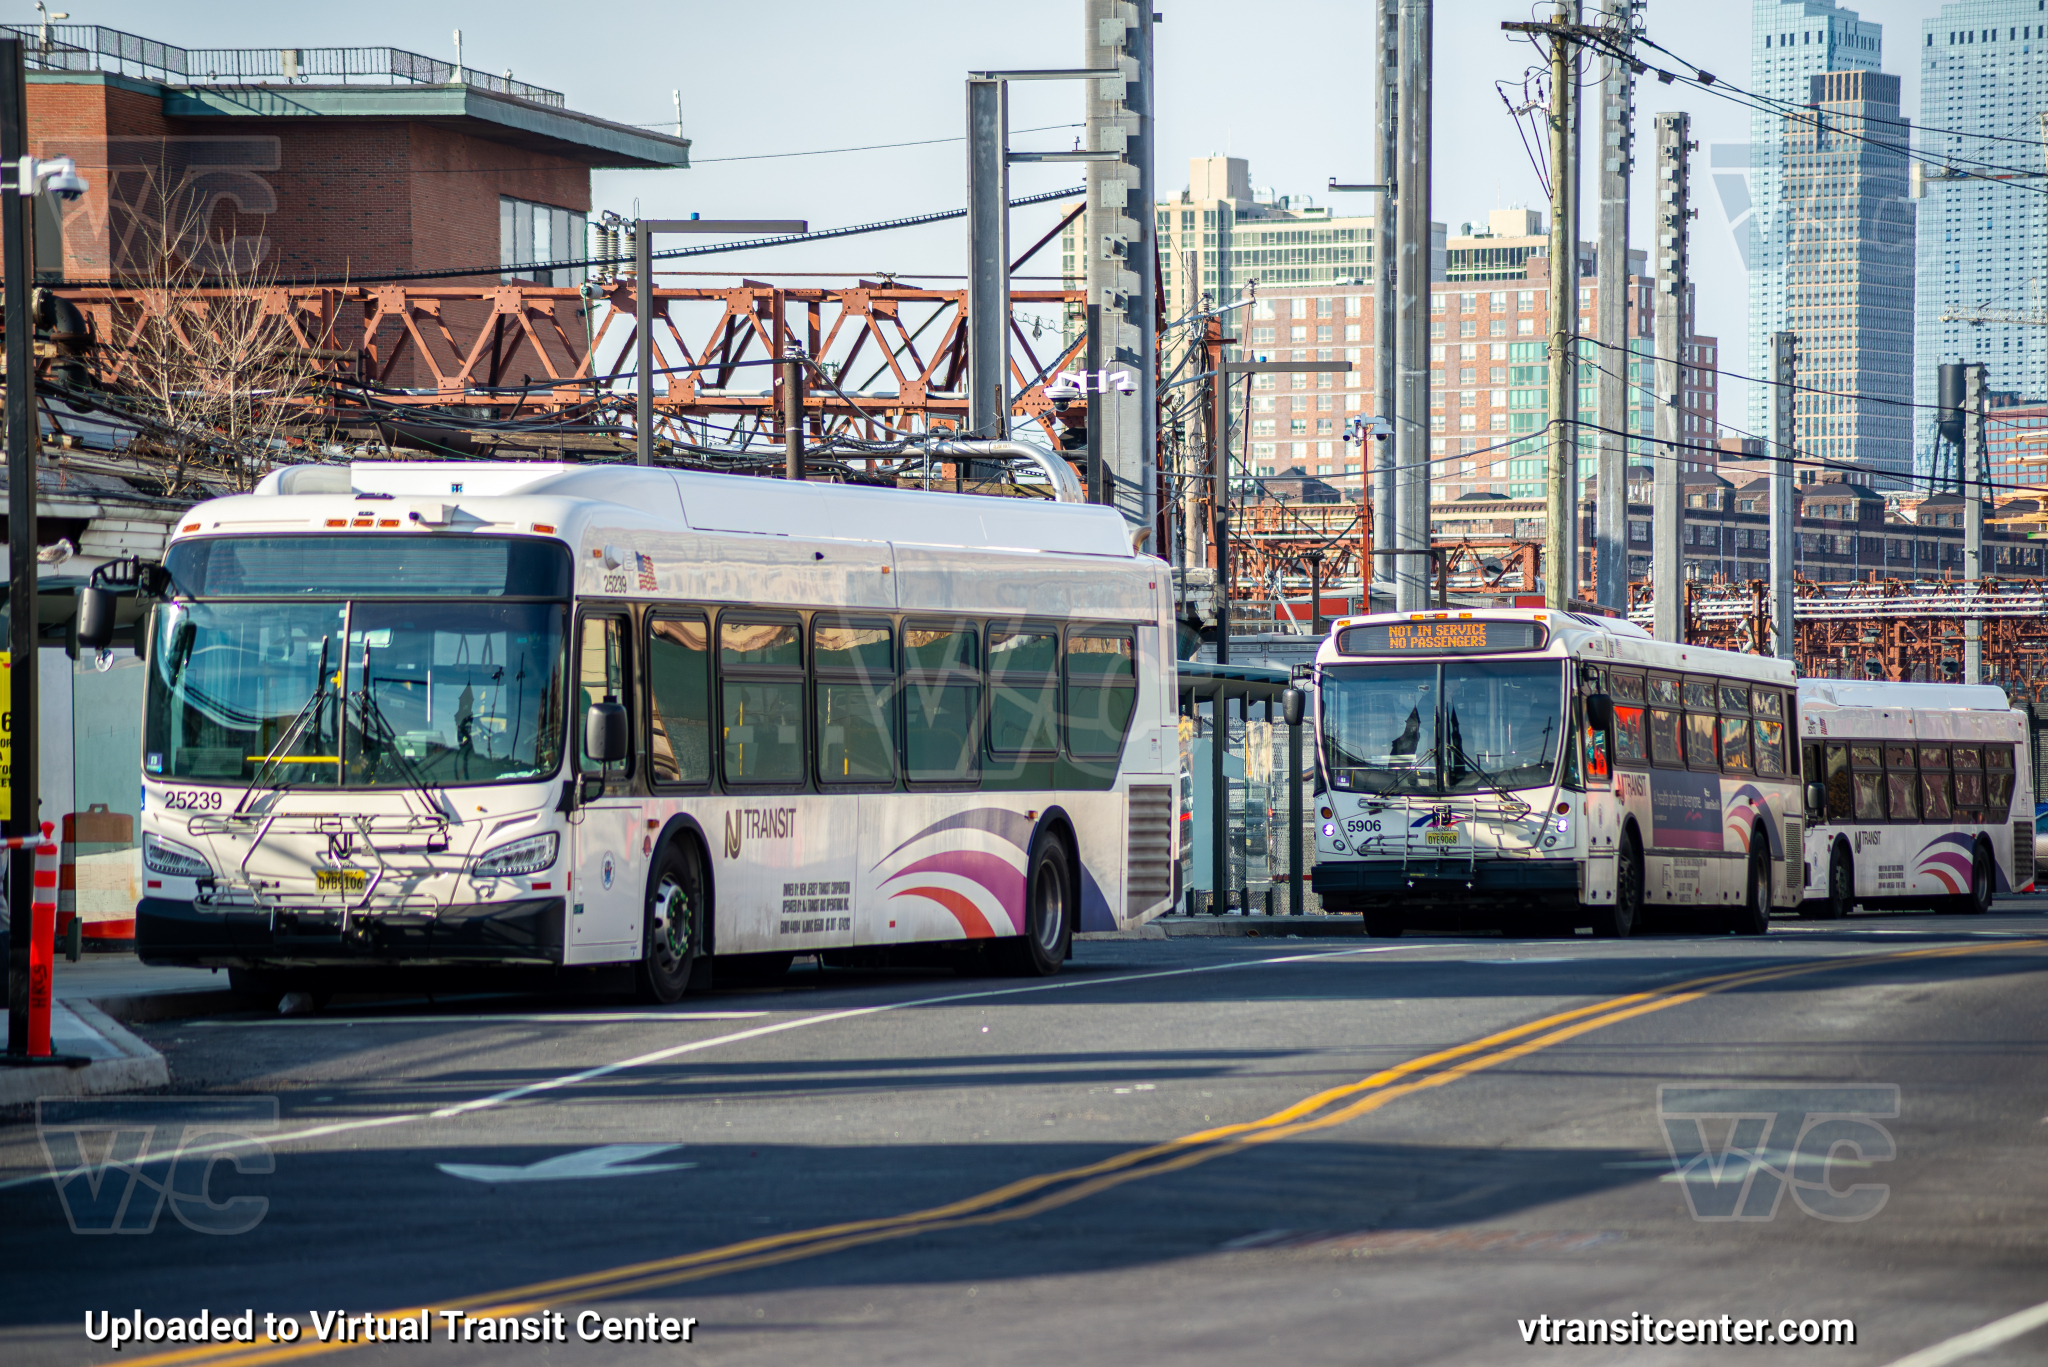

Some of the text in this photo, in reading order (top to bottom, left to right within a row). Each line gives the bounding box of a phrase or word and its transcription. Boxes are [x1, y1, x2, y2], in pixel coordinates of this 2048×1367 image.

[604, 575, 627, 594] 25239
[1388, 624, 1487, 637] NOT IN SERVICE
[1389, 636, 1487, 649] NO PASSENGERS
[164, 791, 222, 810] 25239
[1347, 820, 1382, 832] 5906
[723, 807, 797, 860] NJ TRANSIT
[1862, 831, 1882, 845] TRANSIT
